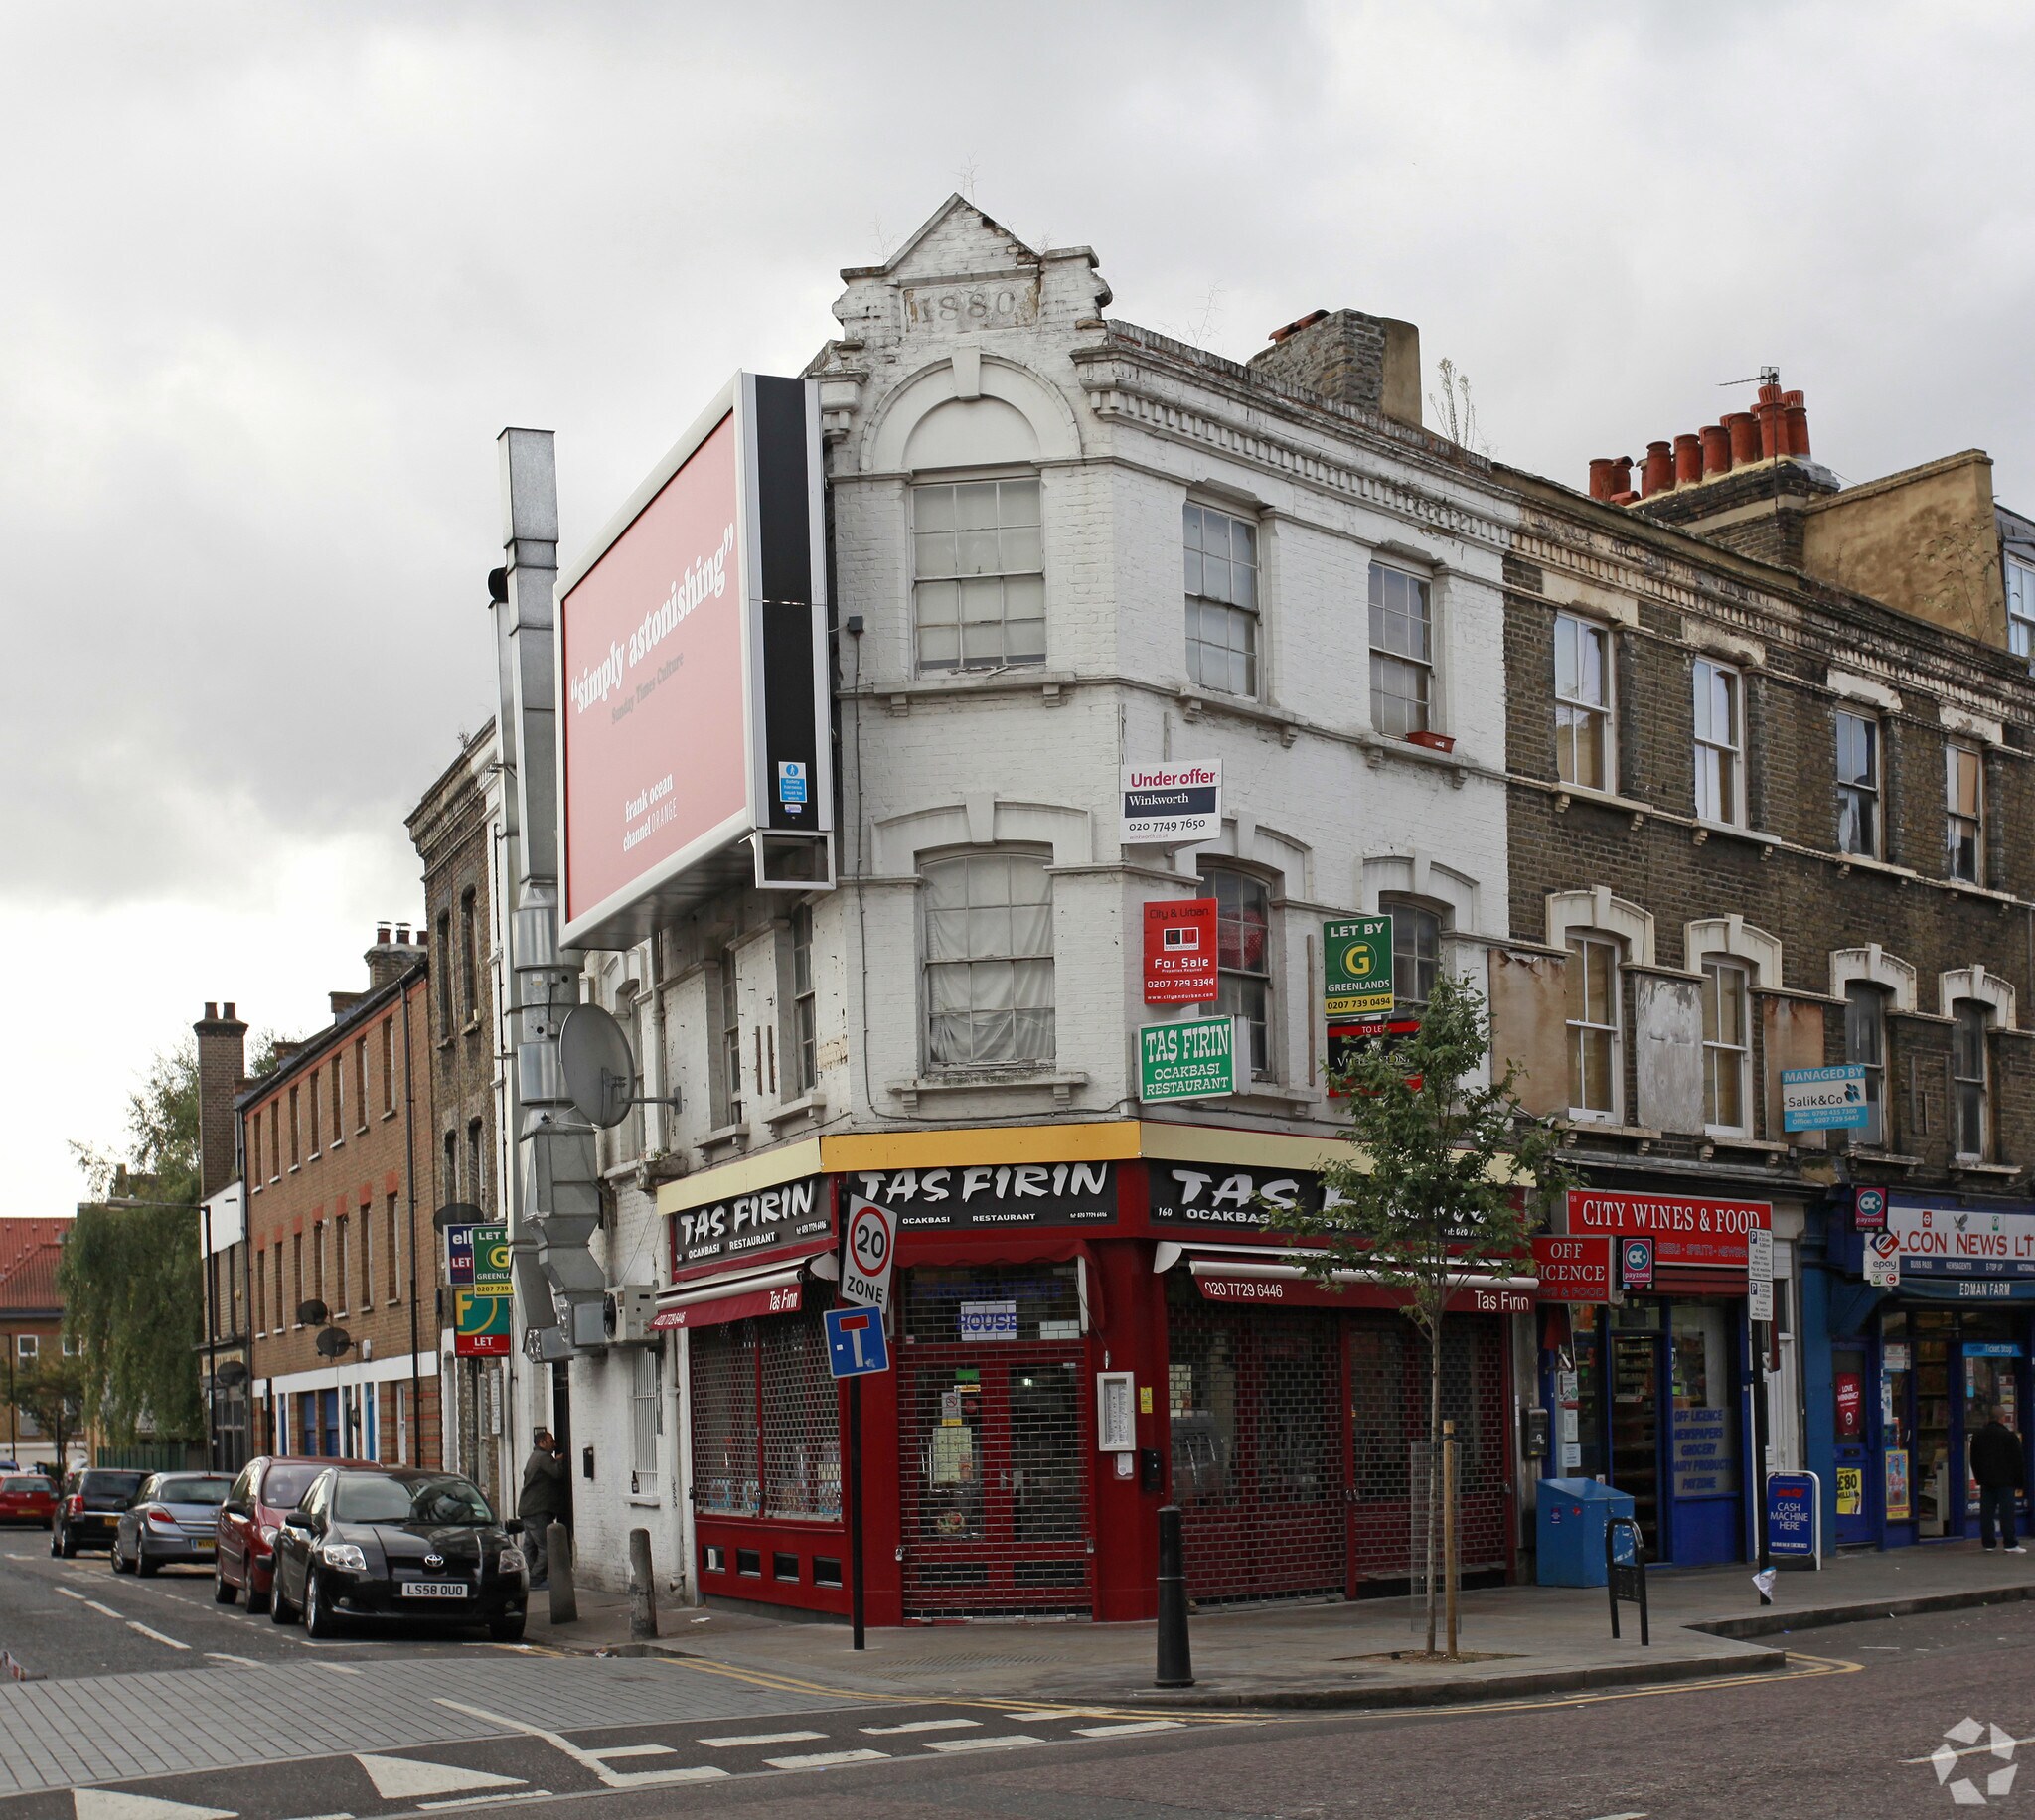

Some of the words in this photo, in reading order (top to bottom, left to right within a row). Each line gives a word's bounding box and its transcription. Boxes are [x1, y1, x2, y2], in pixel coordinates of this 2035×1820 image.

[920, 290, 1016, 323] 1880
[611, 695, 634, 725] Sunday
[635, 677, 656, 704] Times
[657, 652, 684, 686] Culture
[1131, 770, 1177, 788] Under
[1179, 768, 1215, 785] offer
[625, 788, 648, 823] frank
[649, 774, 673, 804] ocean
[1129, 792, 1189, 806] Winkworth
[623, 815, 651, 852] channel
[651, 797, 677, 833] ORANGE
[1153, 821, 1177, 832] 7749
[1180, 818, 1205, 831] 7650
[1150, 909, 1168, 920] City
[1179, 907, 1209, 917] Urban
[1331, 925, 1358, 937] LET
[1364, 922, 1384, 935] BY
[1155, 958, 1175, 969] For
[1181, 957, 1209, 968] Sale
[1345, 945, 1370, 974] G
[1147, 980, 1171, 988] 0207
[1174, 979, 1190, 987] 729
[1193, 978, 1214, 986] 3344
[1328, 980, 1390, 991] GREENLANDS
[1370, 997, 1390, 1006] 0494
[1145, 1029, 1178, 1064] TAŞ
[1182, 1024, 1229, 1059] FIRIN
[1785, 1068, 1845, 1082] MANAGED
[1848, 1067, 1863, 1077] BY
[1146, 1076, 1228, 1095] RESTAURANT
[1789, 1094, 1843, 1107] Salik&Co
[858, 1168, 951, 1204] TAS
[962, 1161, 1108, 1203] FIRIN
[1172, 1169, 1300, 1210] TAS
[680, 1204, 726, 1246] TAS
[733, 1180, 814, 1234] FIRIN
[1158, 1207, 1173, 1217] 160
[1582, 1199, 1626, 1227] CITY
[1632, 1203, 1694, 1231] WINES
[1699, 1207, 1711, 1233] &
[1715, 1209, 1760, 1235] FOOD
[902, 1216, 951, 1225] OCAKBASI
[972, 1213, 1035, 1222] RESTAURANT
[478, 1231, 501, 1240] LET
[857, 1224, 885, 1259] 20
[688, 1243, 720, 1259] OCAKBASI
[729, 1232, 776, 1251] RESTAURANT
[1550, 1243, 1584, 1259] OFF
[1956, 1233, 2008, 1256] NEWS
[452, 1257, 471, 1268] LET
[1873, 1260, 1897, 1270] epay
[1922, 1260, 1933, 1269] PASS
[1539, 1264, 1606, 1281] ICENCE
[847, 1275, 883, 1305] ZONE
[1227, 1283, 1254, 1296] 7729
[1257, 1284, 1283, 1298] 6446
[1572, 1288, 1606, 1297] FOOD
[1959, 1283, 1987, 1295] EDMAN
[1989, 1283, 2010, 1295] FARM
[956, 1313, 1018, 1331] HOUSE
[474, 1337, 494, 1347] LET
[1984, 1344, 2000, 1353] Ticket
[2001, 1344, 2012, 1355] Stop
[1841, 1384, 1853, 1393] LOVE
[1674, 1411, 1689, 1422] OFF
[1690, 1409, 1723, 1422] LICENCE
[1674, 1427, 1724, 1440] NEWSPAPERS
[1681, 1443, 1717, 1456] GROCERY
[1683, 1477, 1716, 1489] PAYZONE
[1838, 1474, 1857, 1490] £80
[1777, 1502, 1800, 1511] CASH
[1770, 1512, 1808, 1521] MACHINE
[1779, 1521, 1800, 1530] HERE
[407, 1584, 437, 1595] LS58
